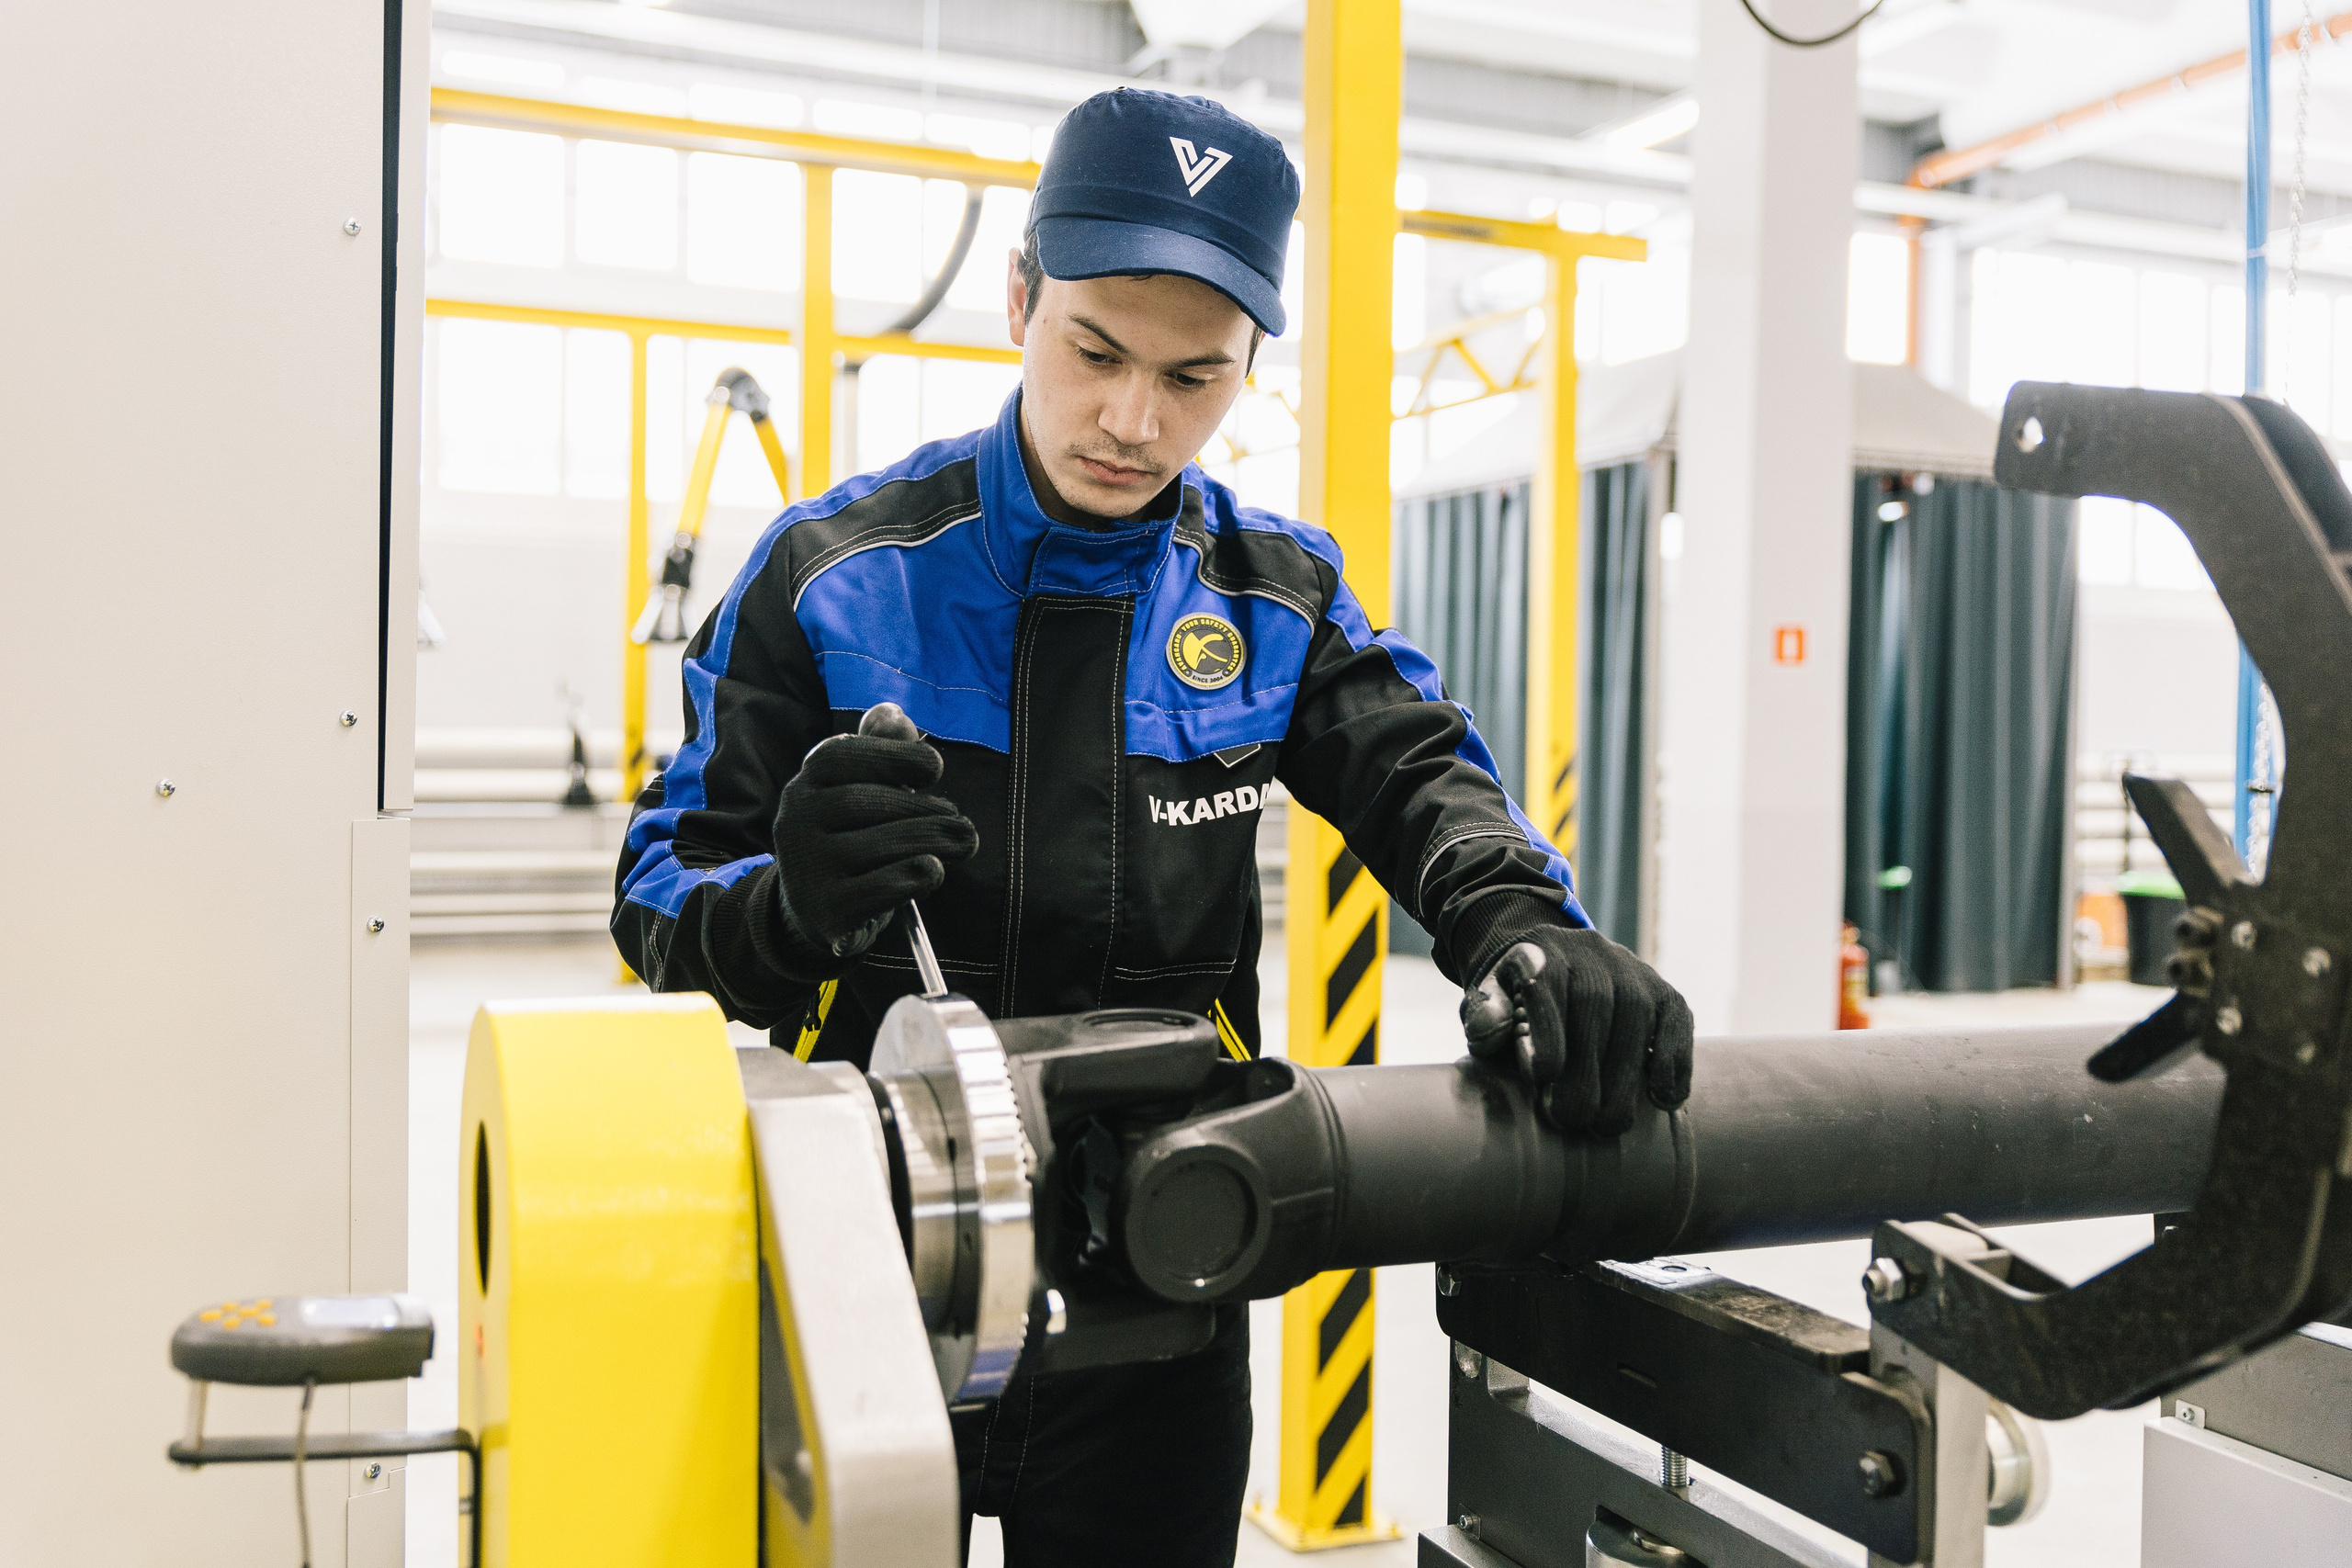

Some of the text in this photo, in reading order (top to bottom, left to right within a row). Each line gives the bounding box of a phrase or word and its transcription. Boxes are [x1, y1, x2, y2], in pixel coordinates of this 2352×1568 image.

[1181, 619, 1199, 632] YOUR
[1200, 619, 1228, 633] SAFETY
[1192, 675, 1208, 683] SINCE
